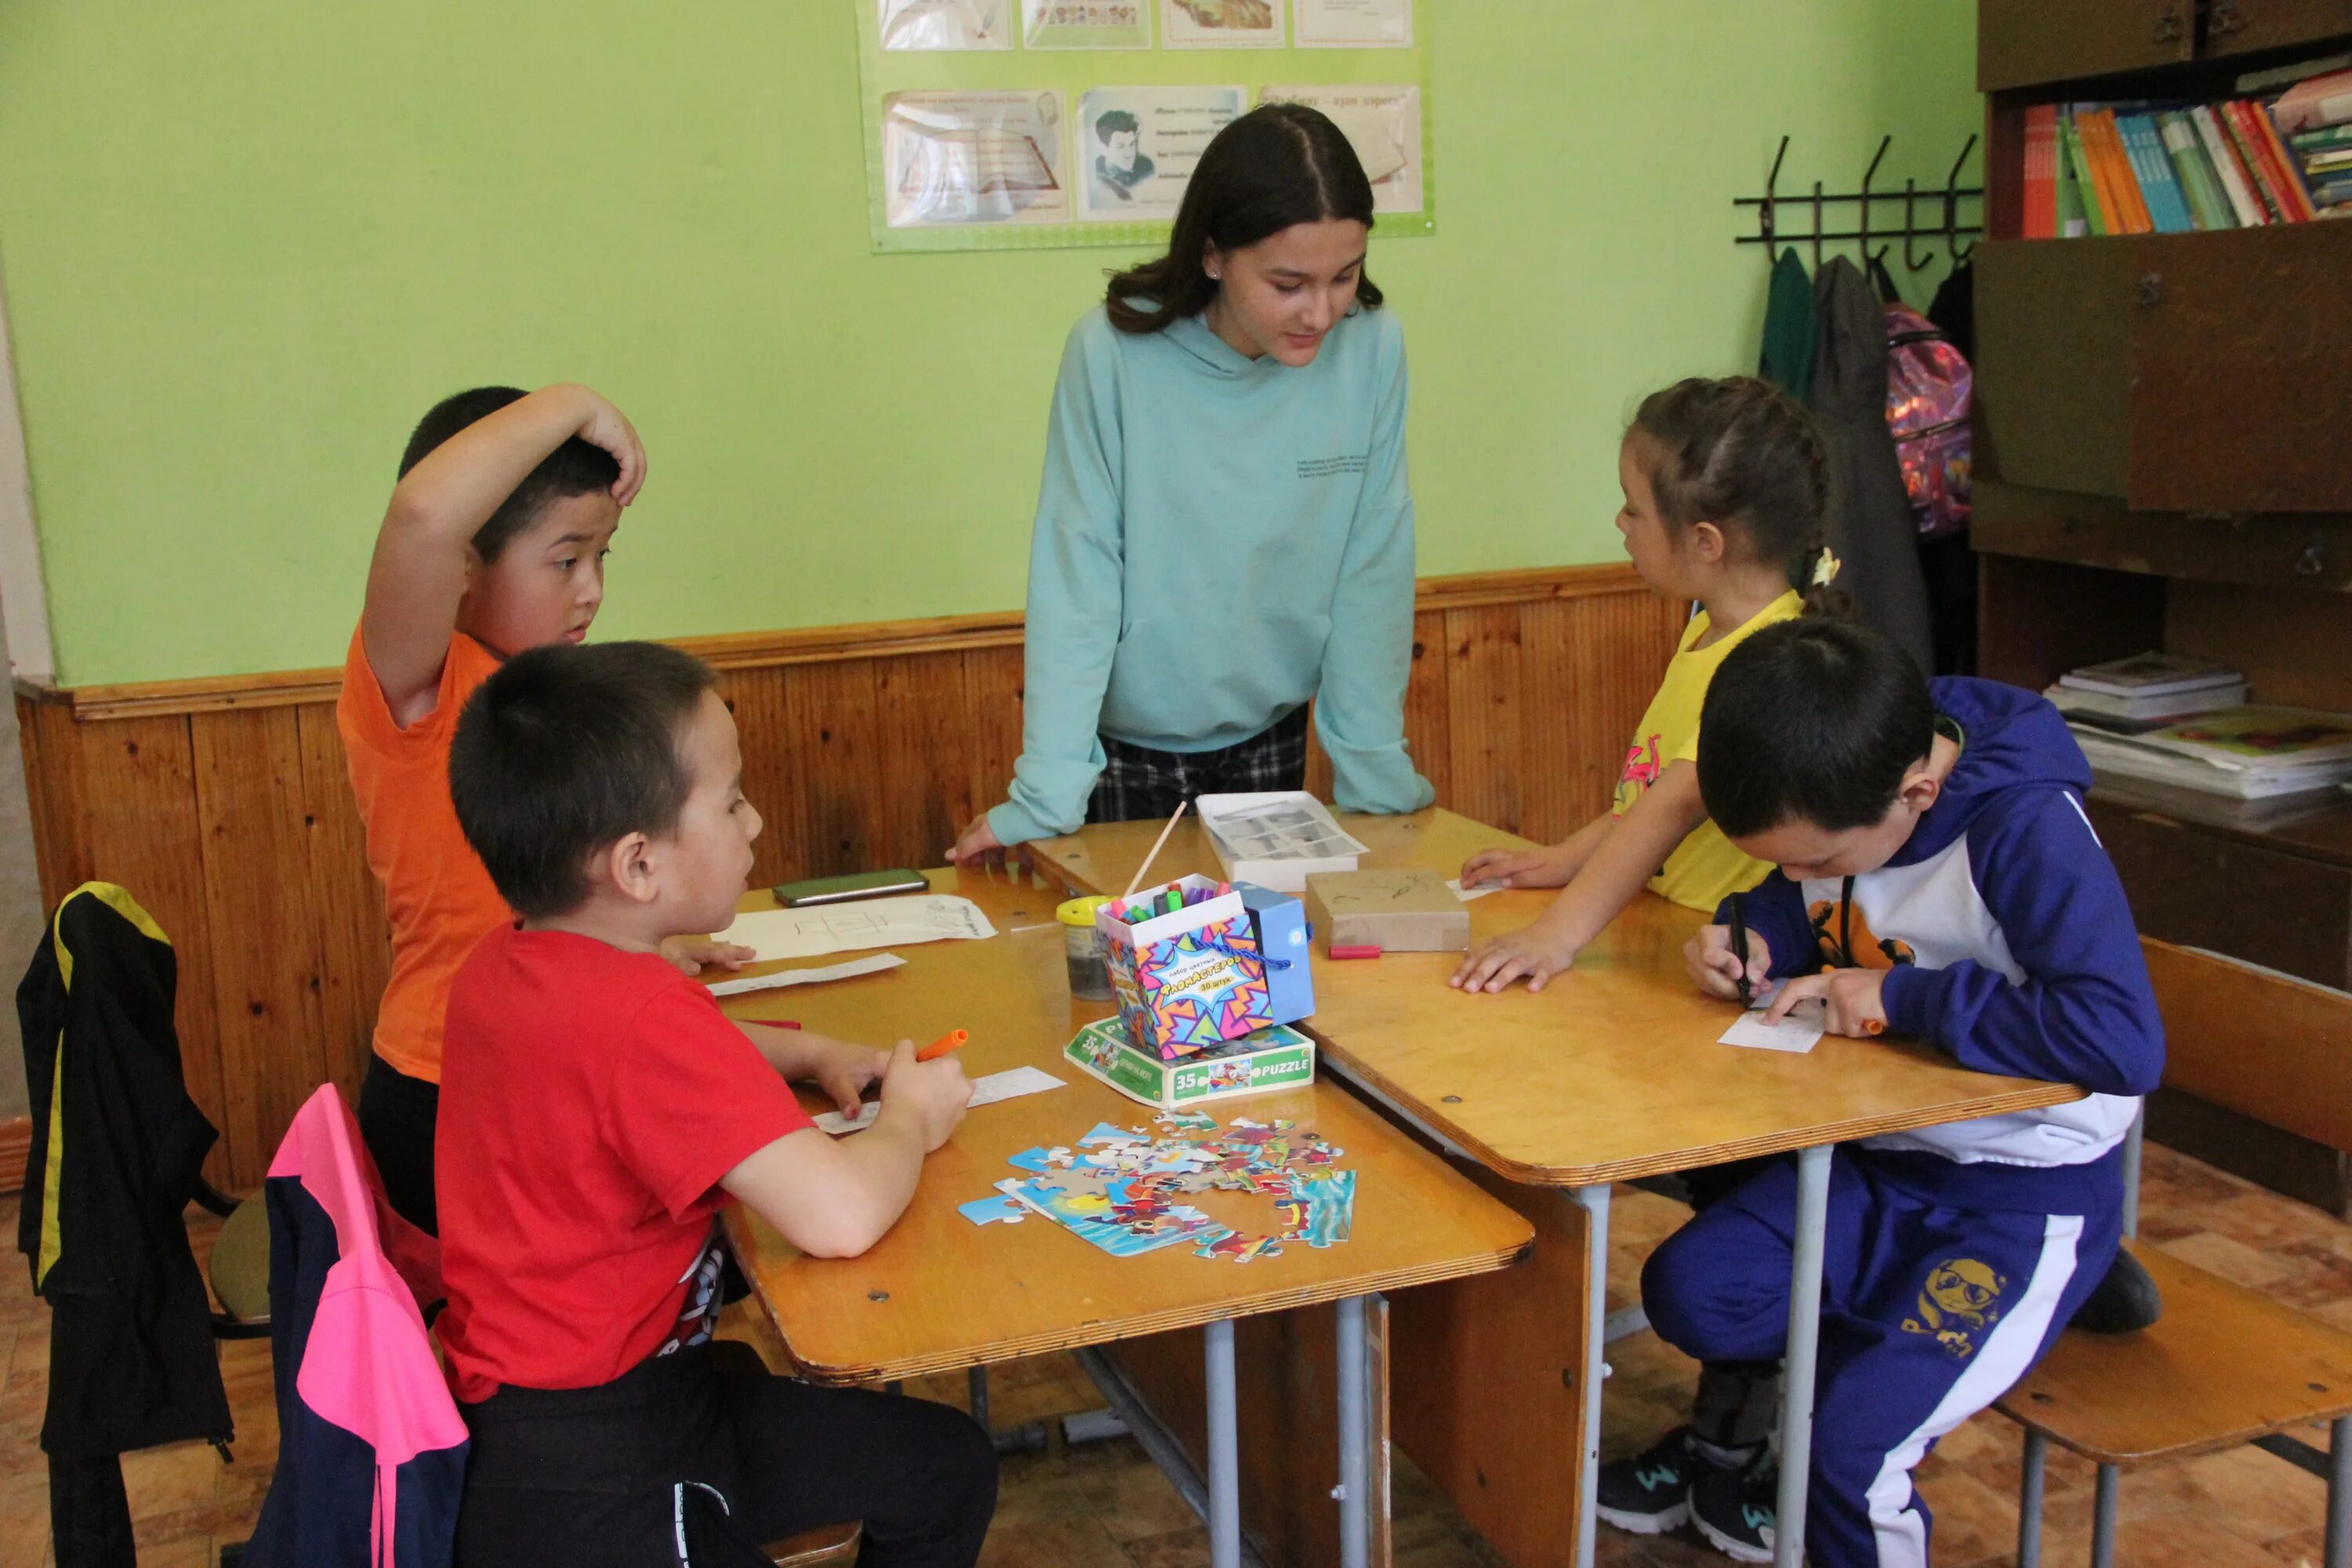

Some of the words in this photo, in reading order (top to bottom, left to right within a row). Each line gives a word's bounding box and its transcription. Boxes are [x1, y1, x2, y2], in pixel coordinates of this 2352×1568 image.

[1169, 967, 1188, 977] набор
[1189, 958, 1215, 971] цветных
[1200, 982, 1211, 992] 30
[1212, 977, 1232, 987] штук
[1261, 1058, 1309, 1076] PUZZLE
[1176, 1073, 1196, 1091] 35
